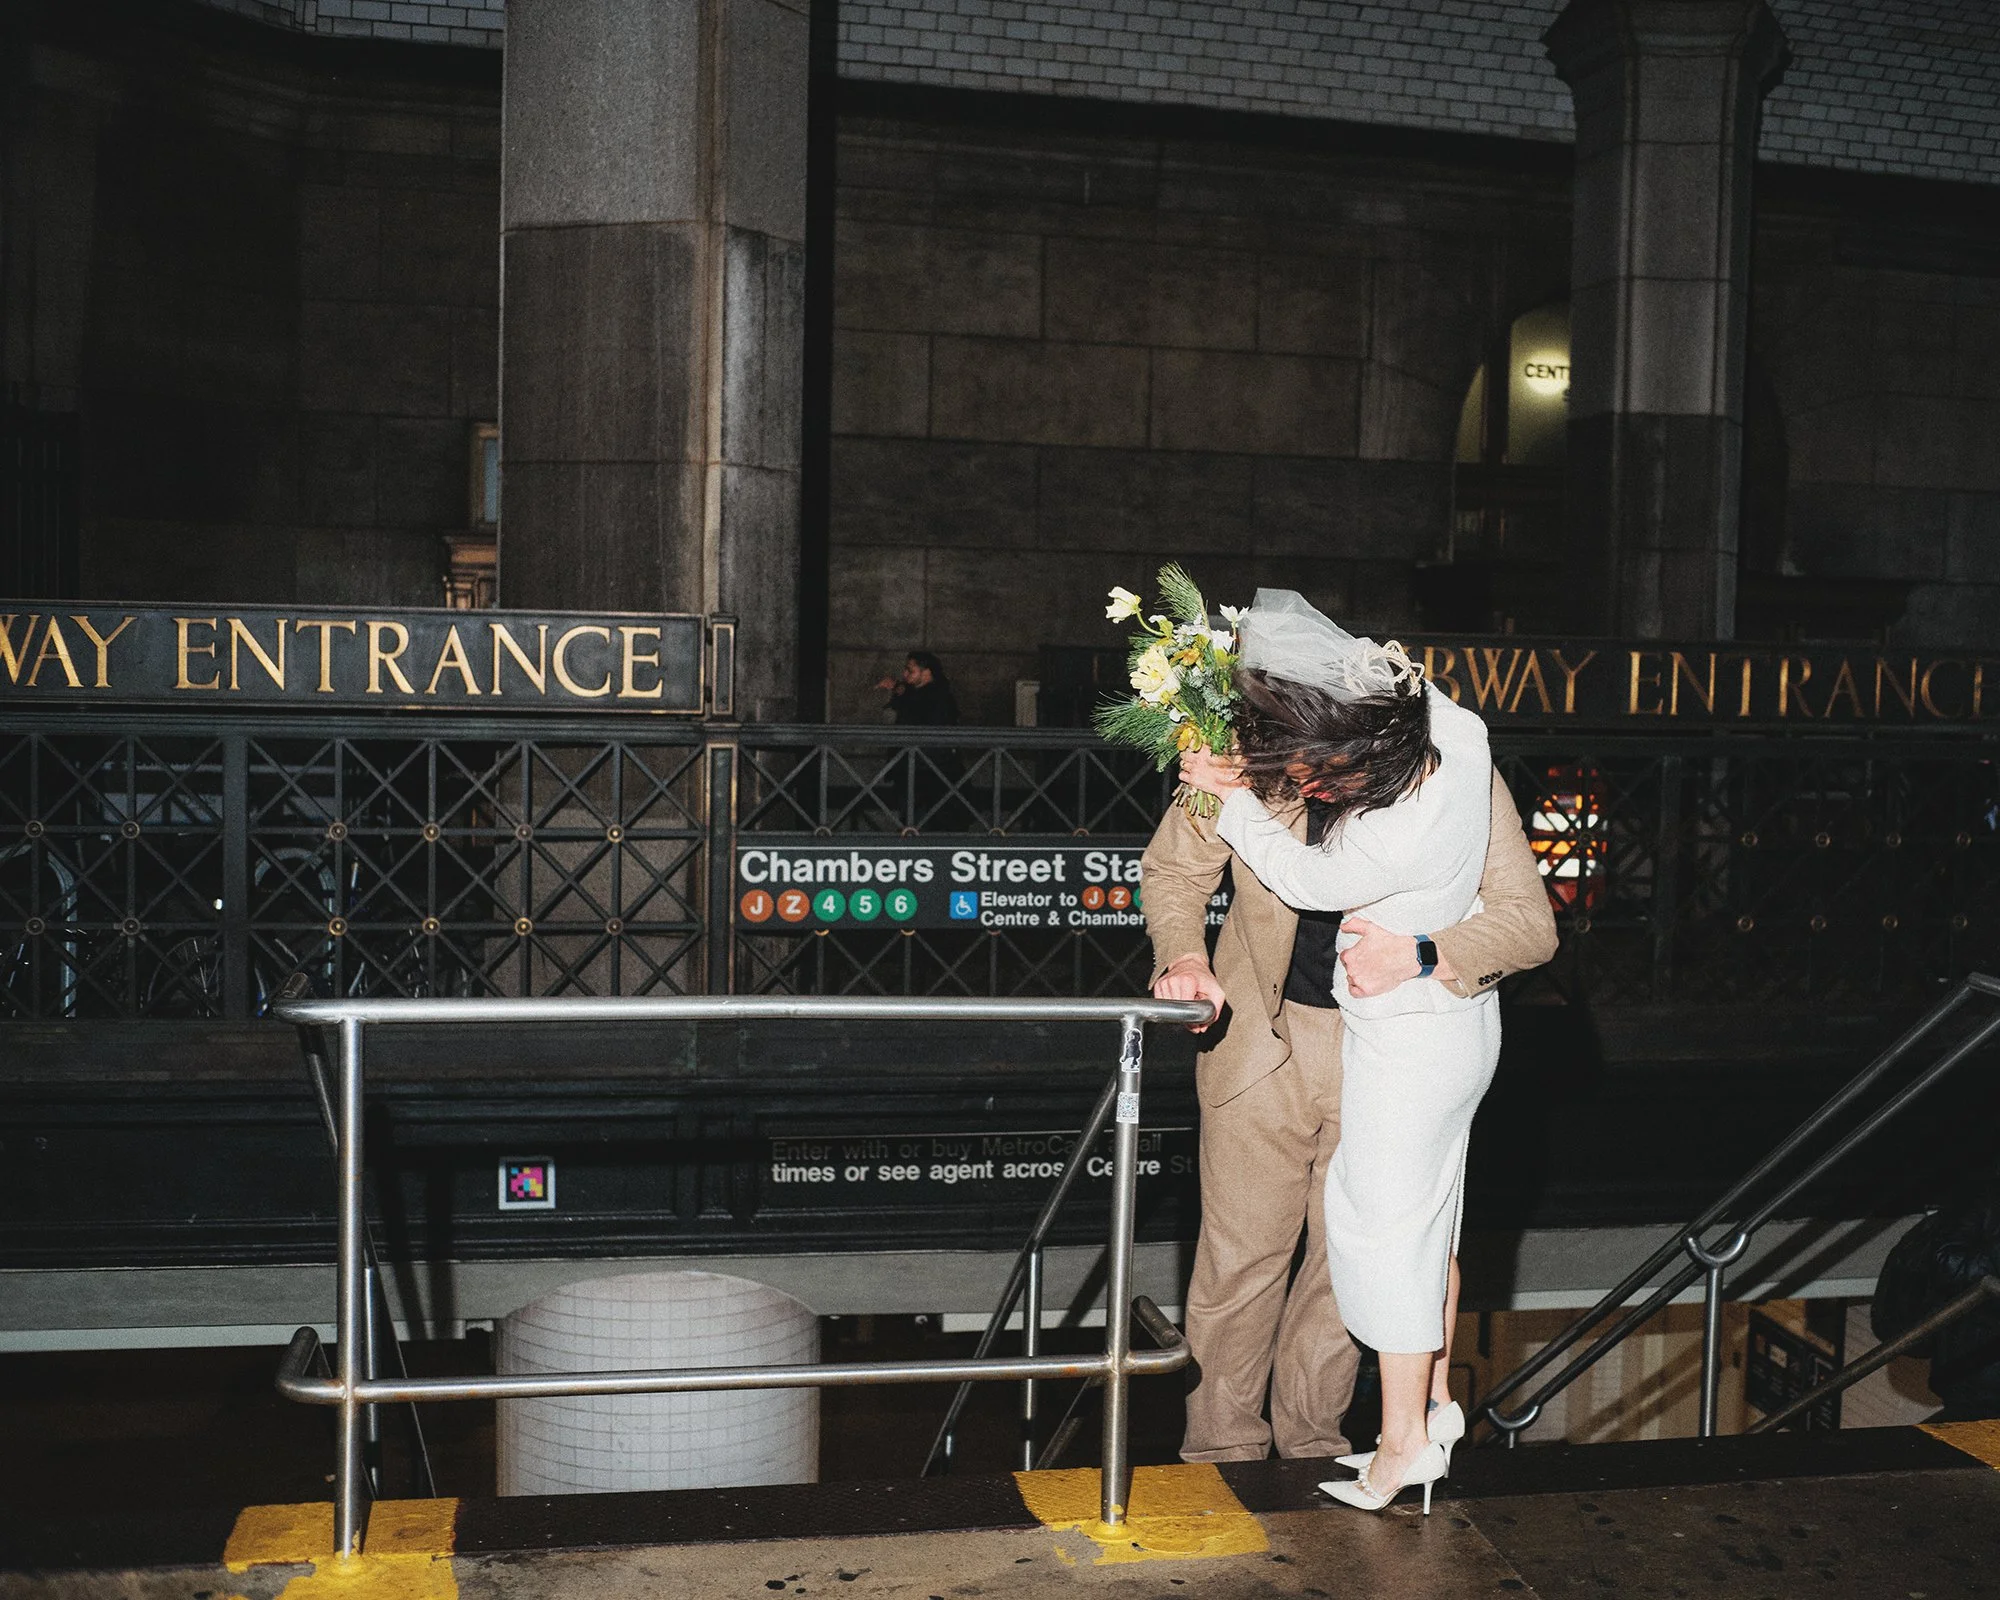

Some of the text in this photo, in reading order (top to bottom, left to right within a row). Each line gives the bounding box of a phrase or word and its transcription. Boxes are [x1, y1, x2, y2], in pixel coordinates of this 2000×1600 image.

[172, 616, 663, 699] ENTRANCE
[1401, 646, 1598, 715] BWAY
[739, 850, 934, 883] Chambers
[950, 850, 1067, 883] Street
[749, 895, 909, 916] J Z 4 5 6
[980, 890, 1229, 907] Elevator to J Z at
[980, 910, 1040, 926] Centre
[1047, 910, 1061, 926] &
[771, 1141, 832, 1161] Enter
[842, 1139, 889, 1160] with
[900, 1142, 923, 1159] or
[931, 1138, 972, 1161] buy
[771, 1162, 836, 1184] times
[844, 1165, 870, 1182] or
[878, 1164, 921, 1182] see
[929, 1160, 995, 1184] agent
[1086, 1156, 1162, 1177] Cere
[1170, 1155, 1193, 1174] St
